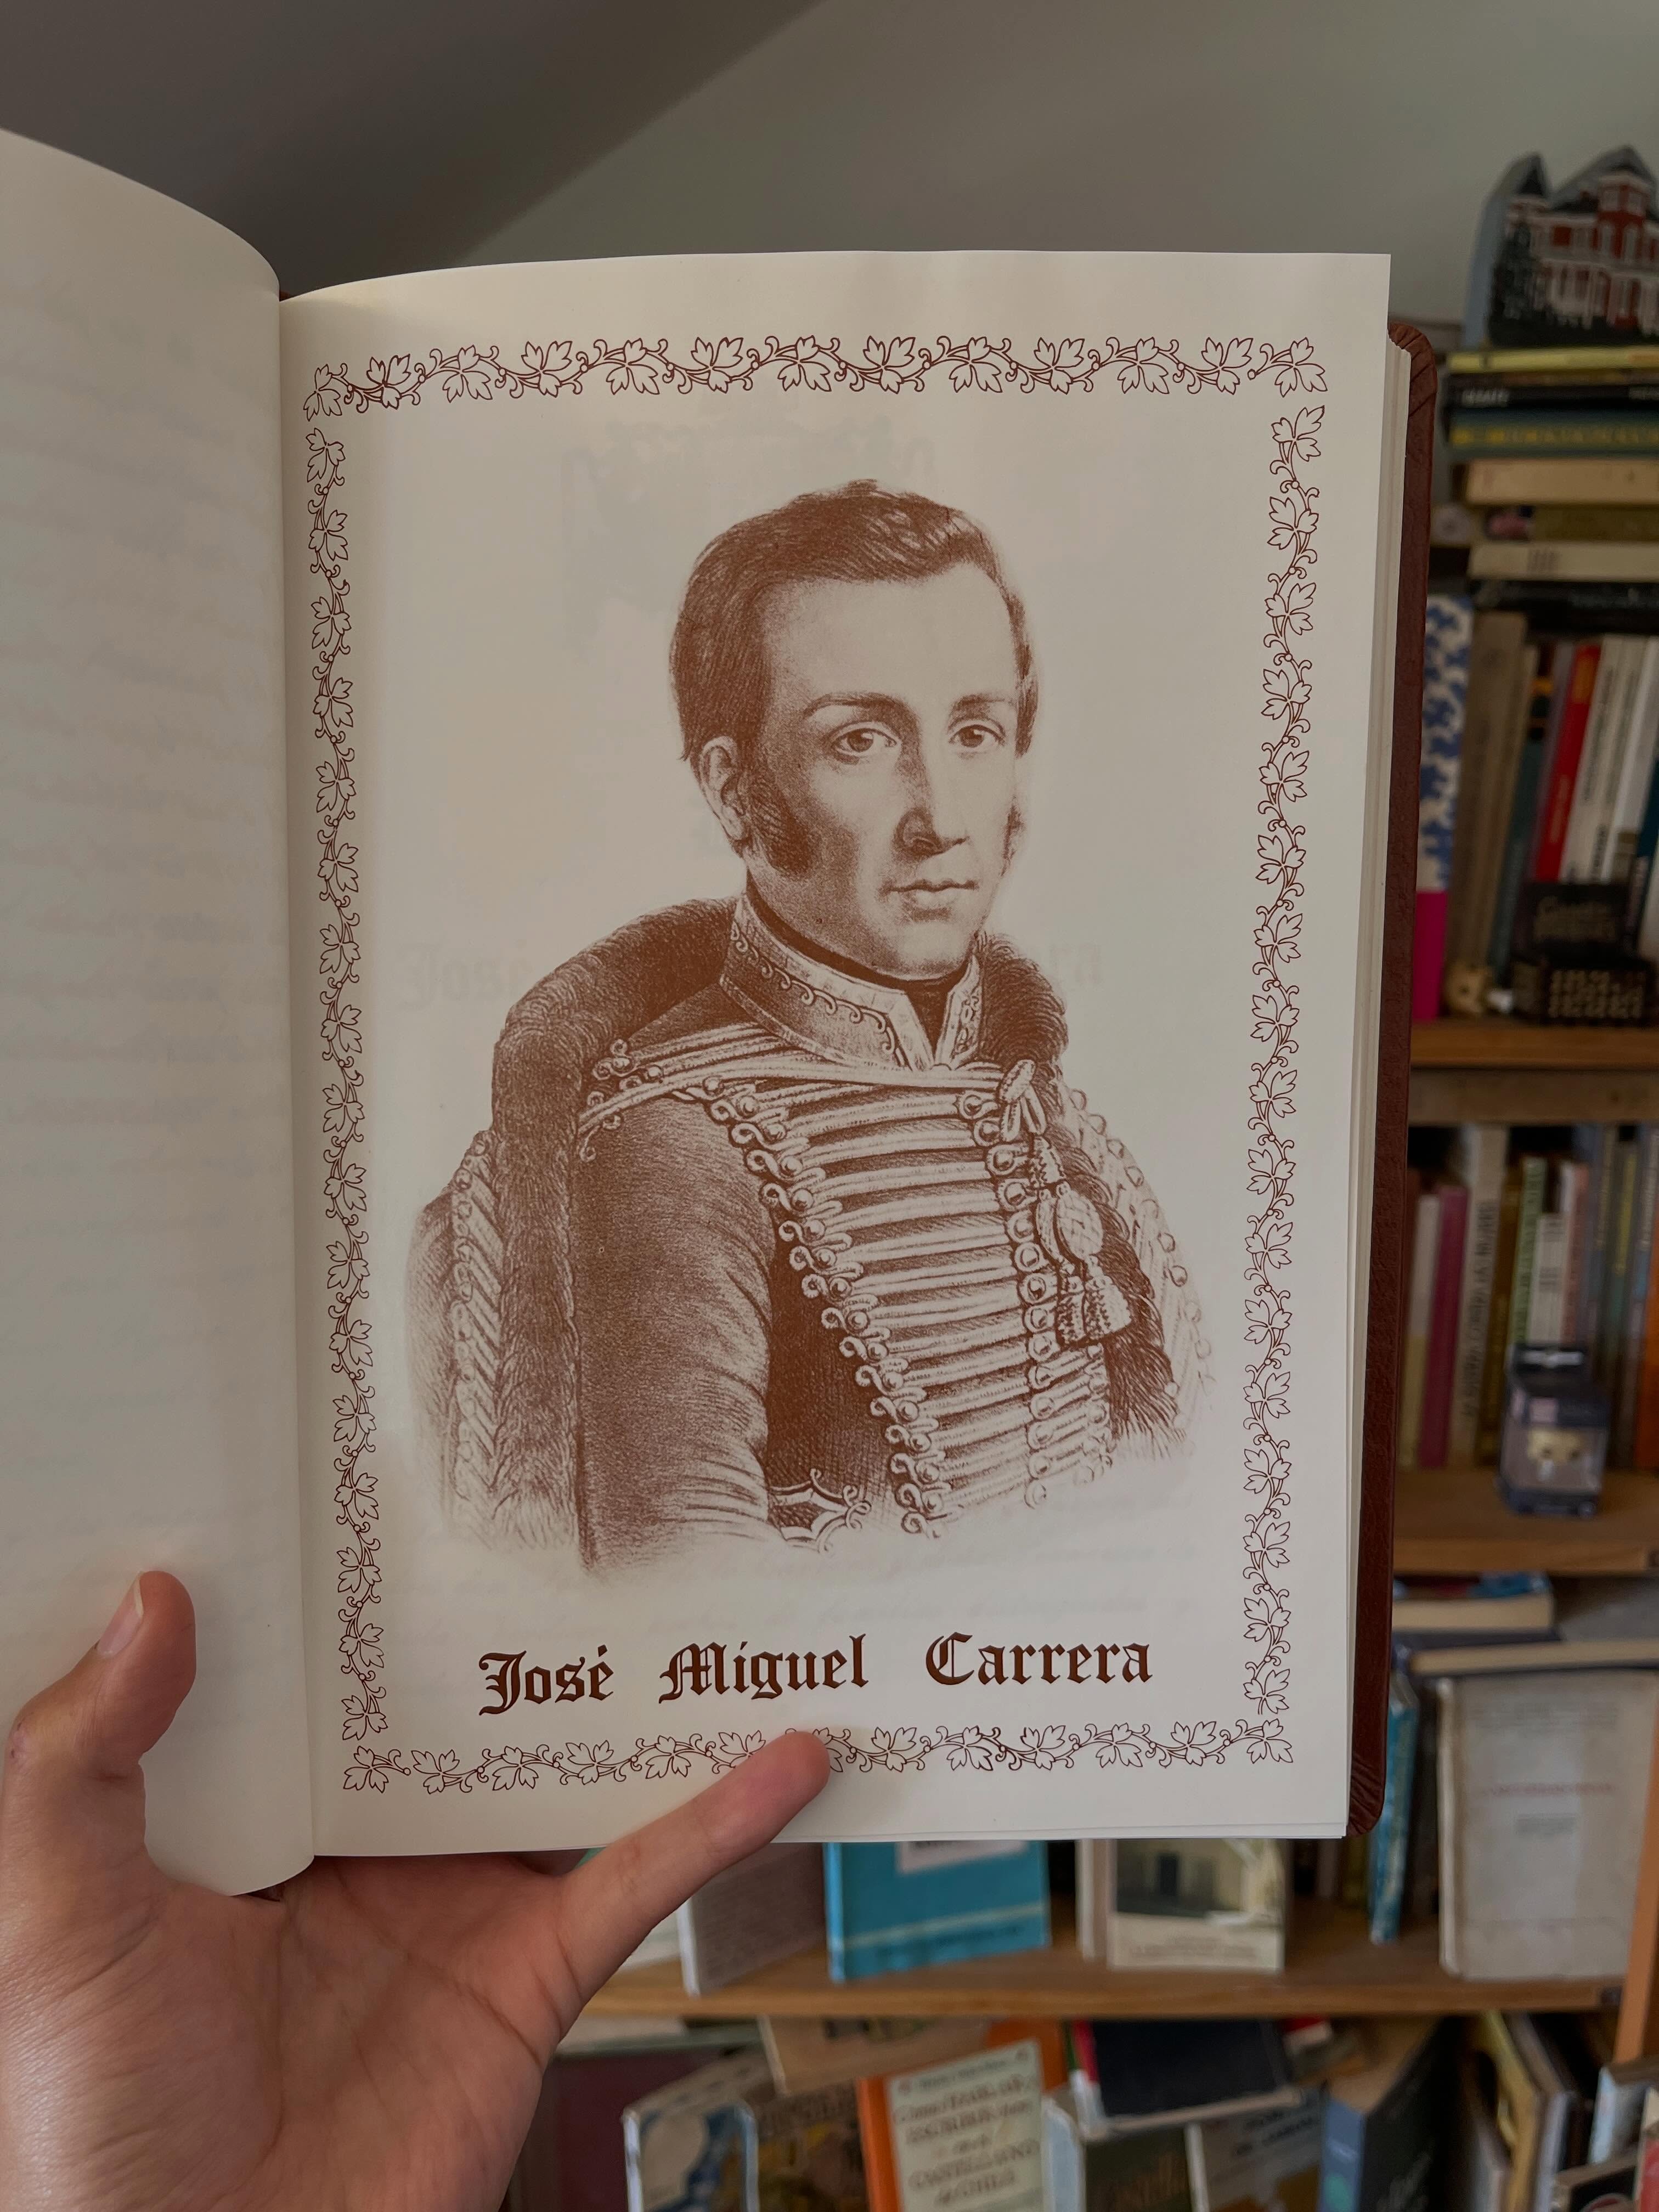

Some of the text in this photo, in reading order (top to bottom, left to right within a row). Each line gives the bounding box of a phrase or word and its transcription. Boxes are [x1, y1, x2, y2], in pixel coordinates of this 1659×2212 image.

[478, 1632, 1153, 1717] José Miguel Carrera
